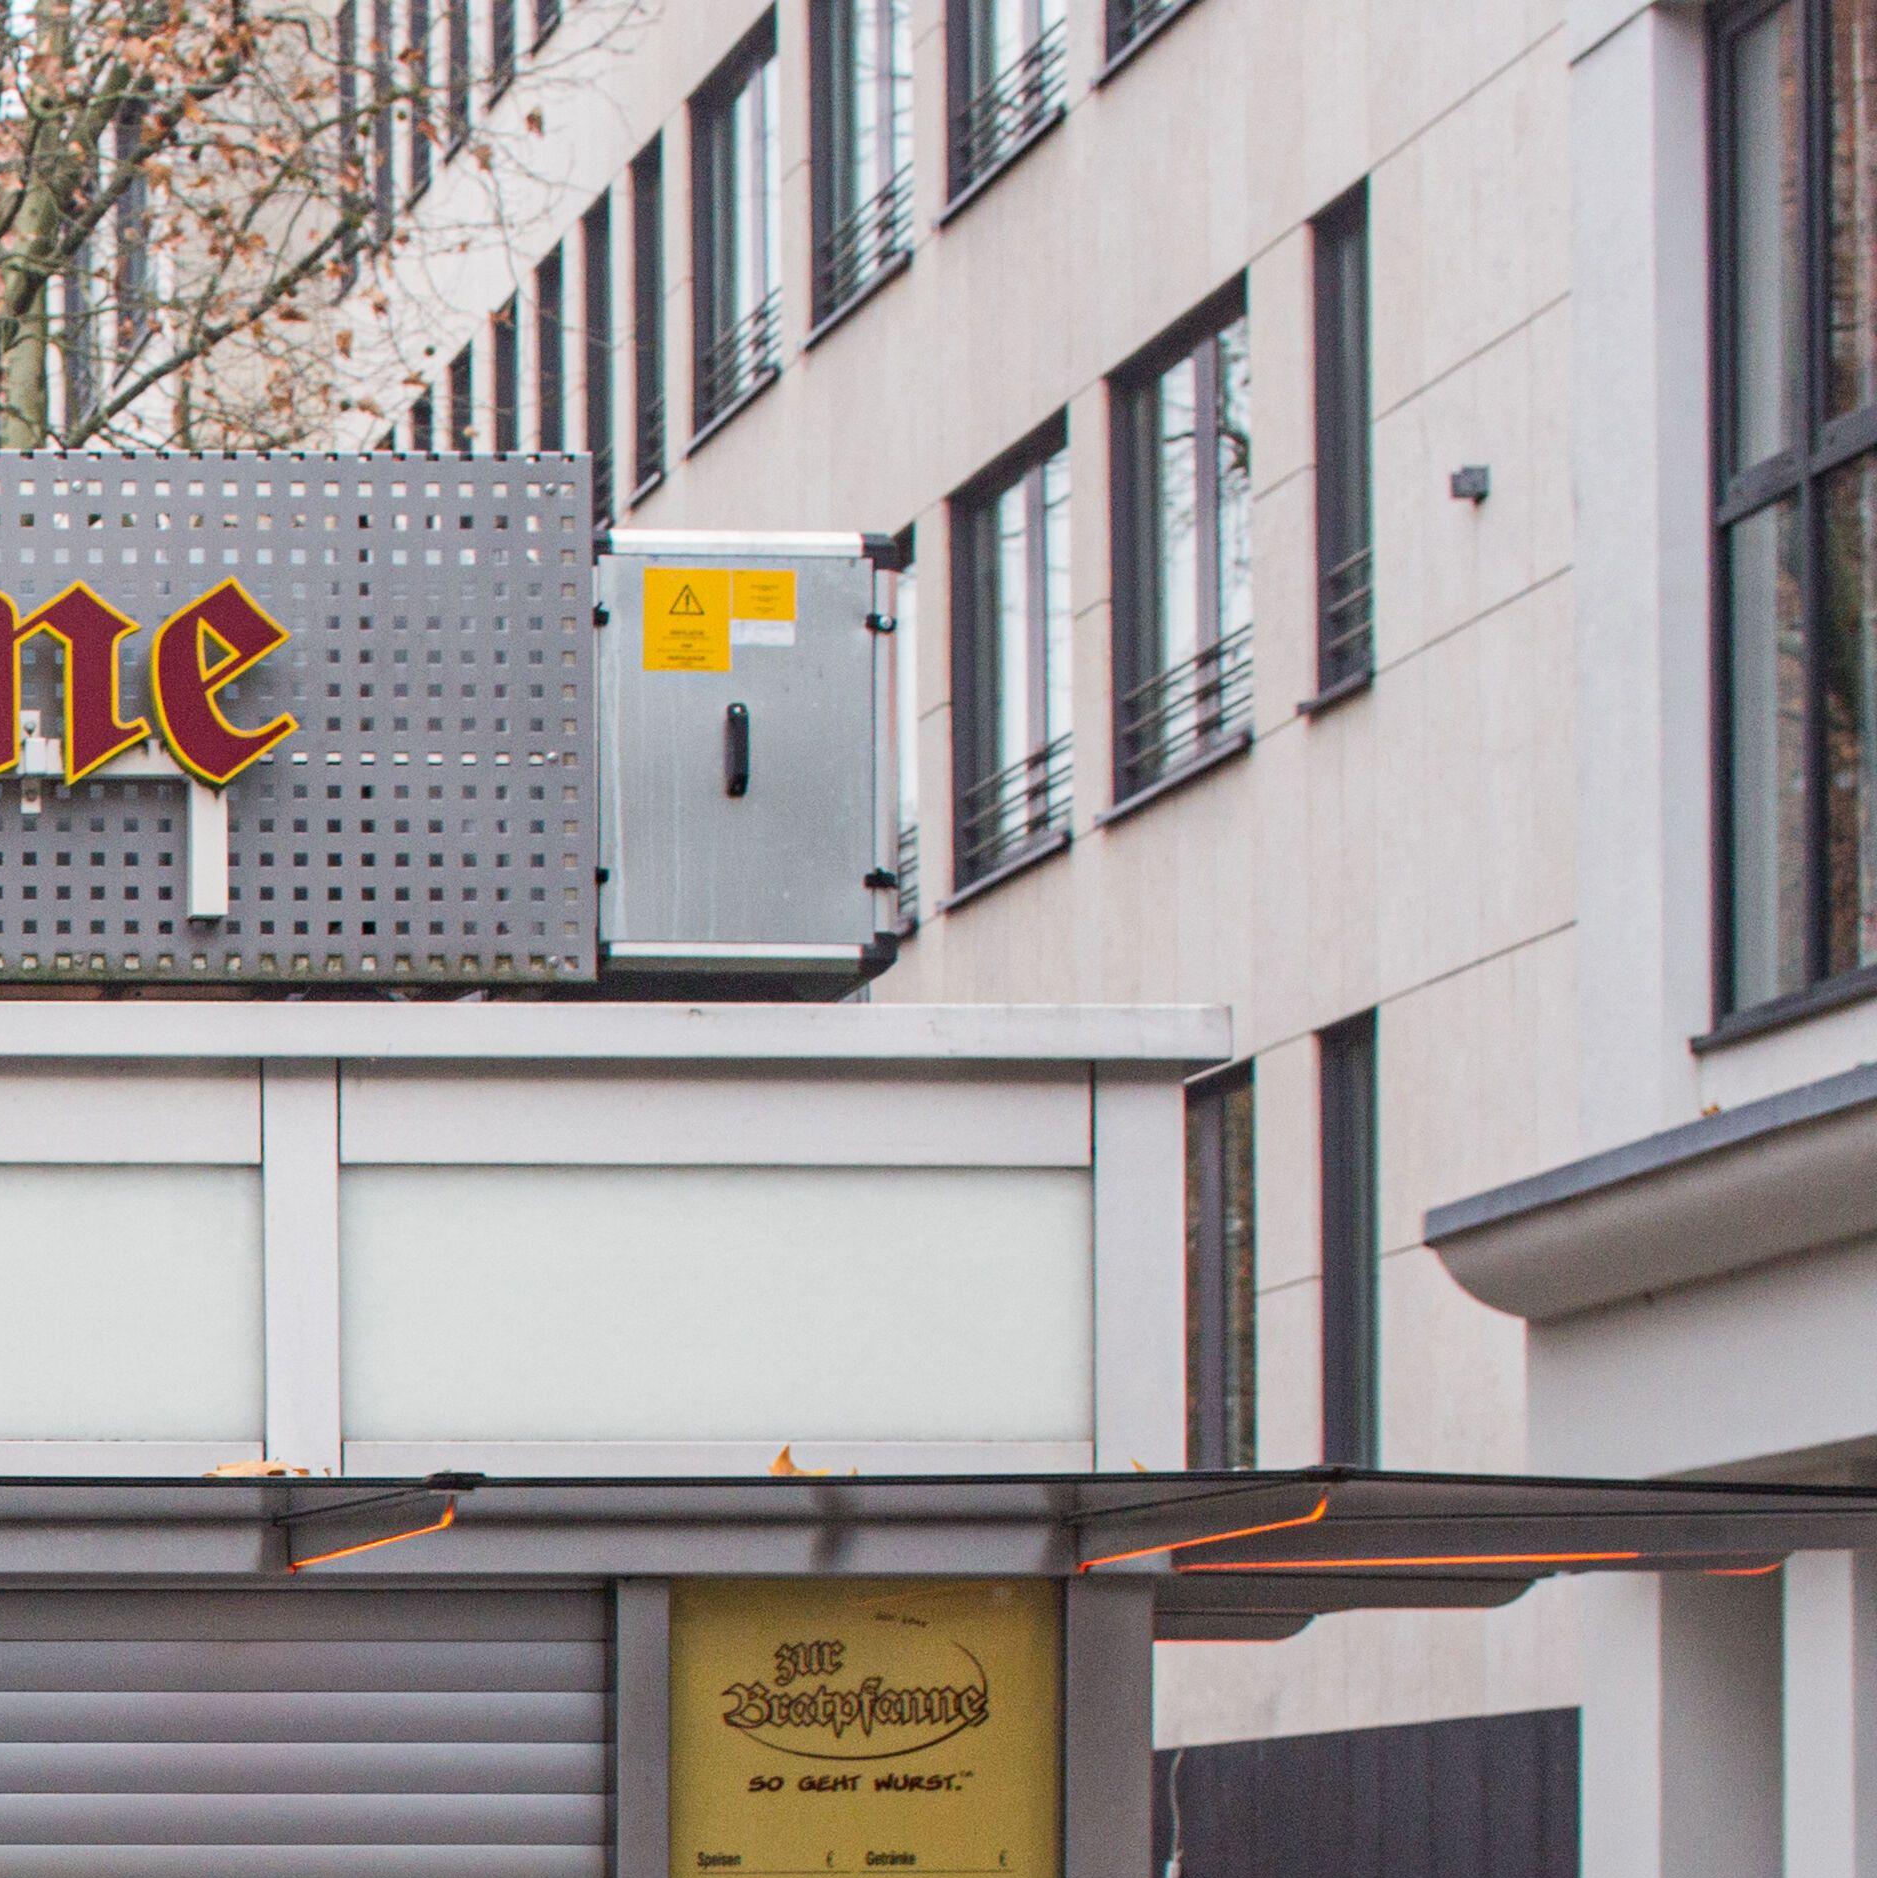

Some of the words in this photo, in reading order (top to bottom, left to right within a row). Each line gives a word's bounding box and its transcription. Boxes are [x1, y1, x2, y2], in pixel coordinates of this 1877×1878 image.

[774, 1639, 845, 1686] zur
[722, 1676, 990, 1739] Bratpfanne
[748, 1776, 785, 1792] SO
[798, 1775, 862, 1792] GEHT
[698, 1852, 741, 1869] Speisen
[866, 1851, 916, 1866] Getränke
